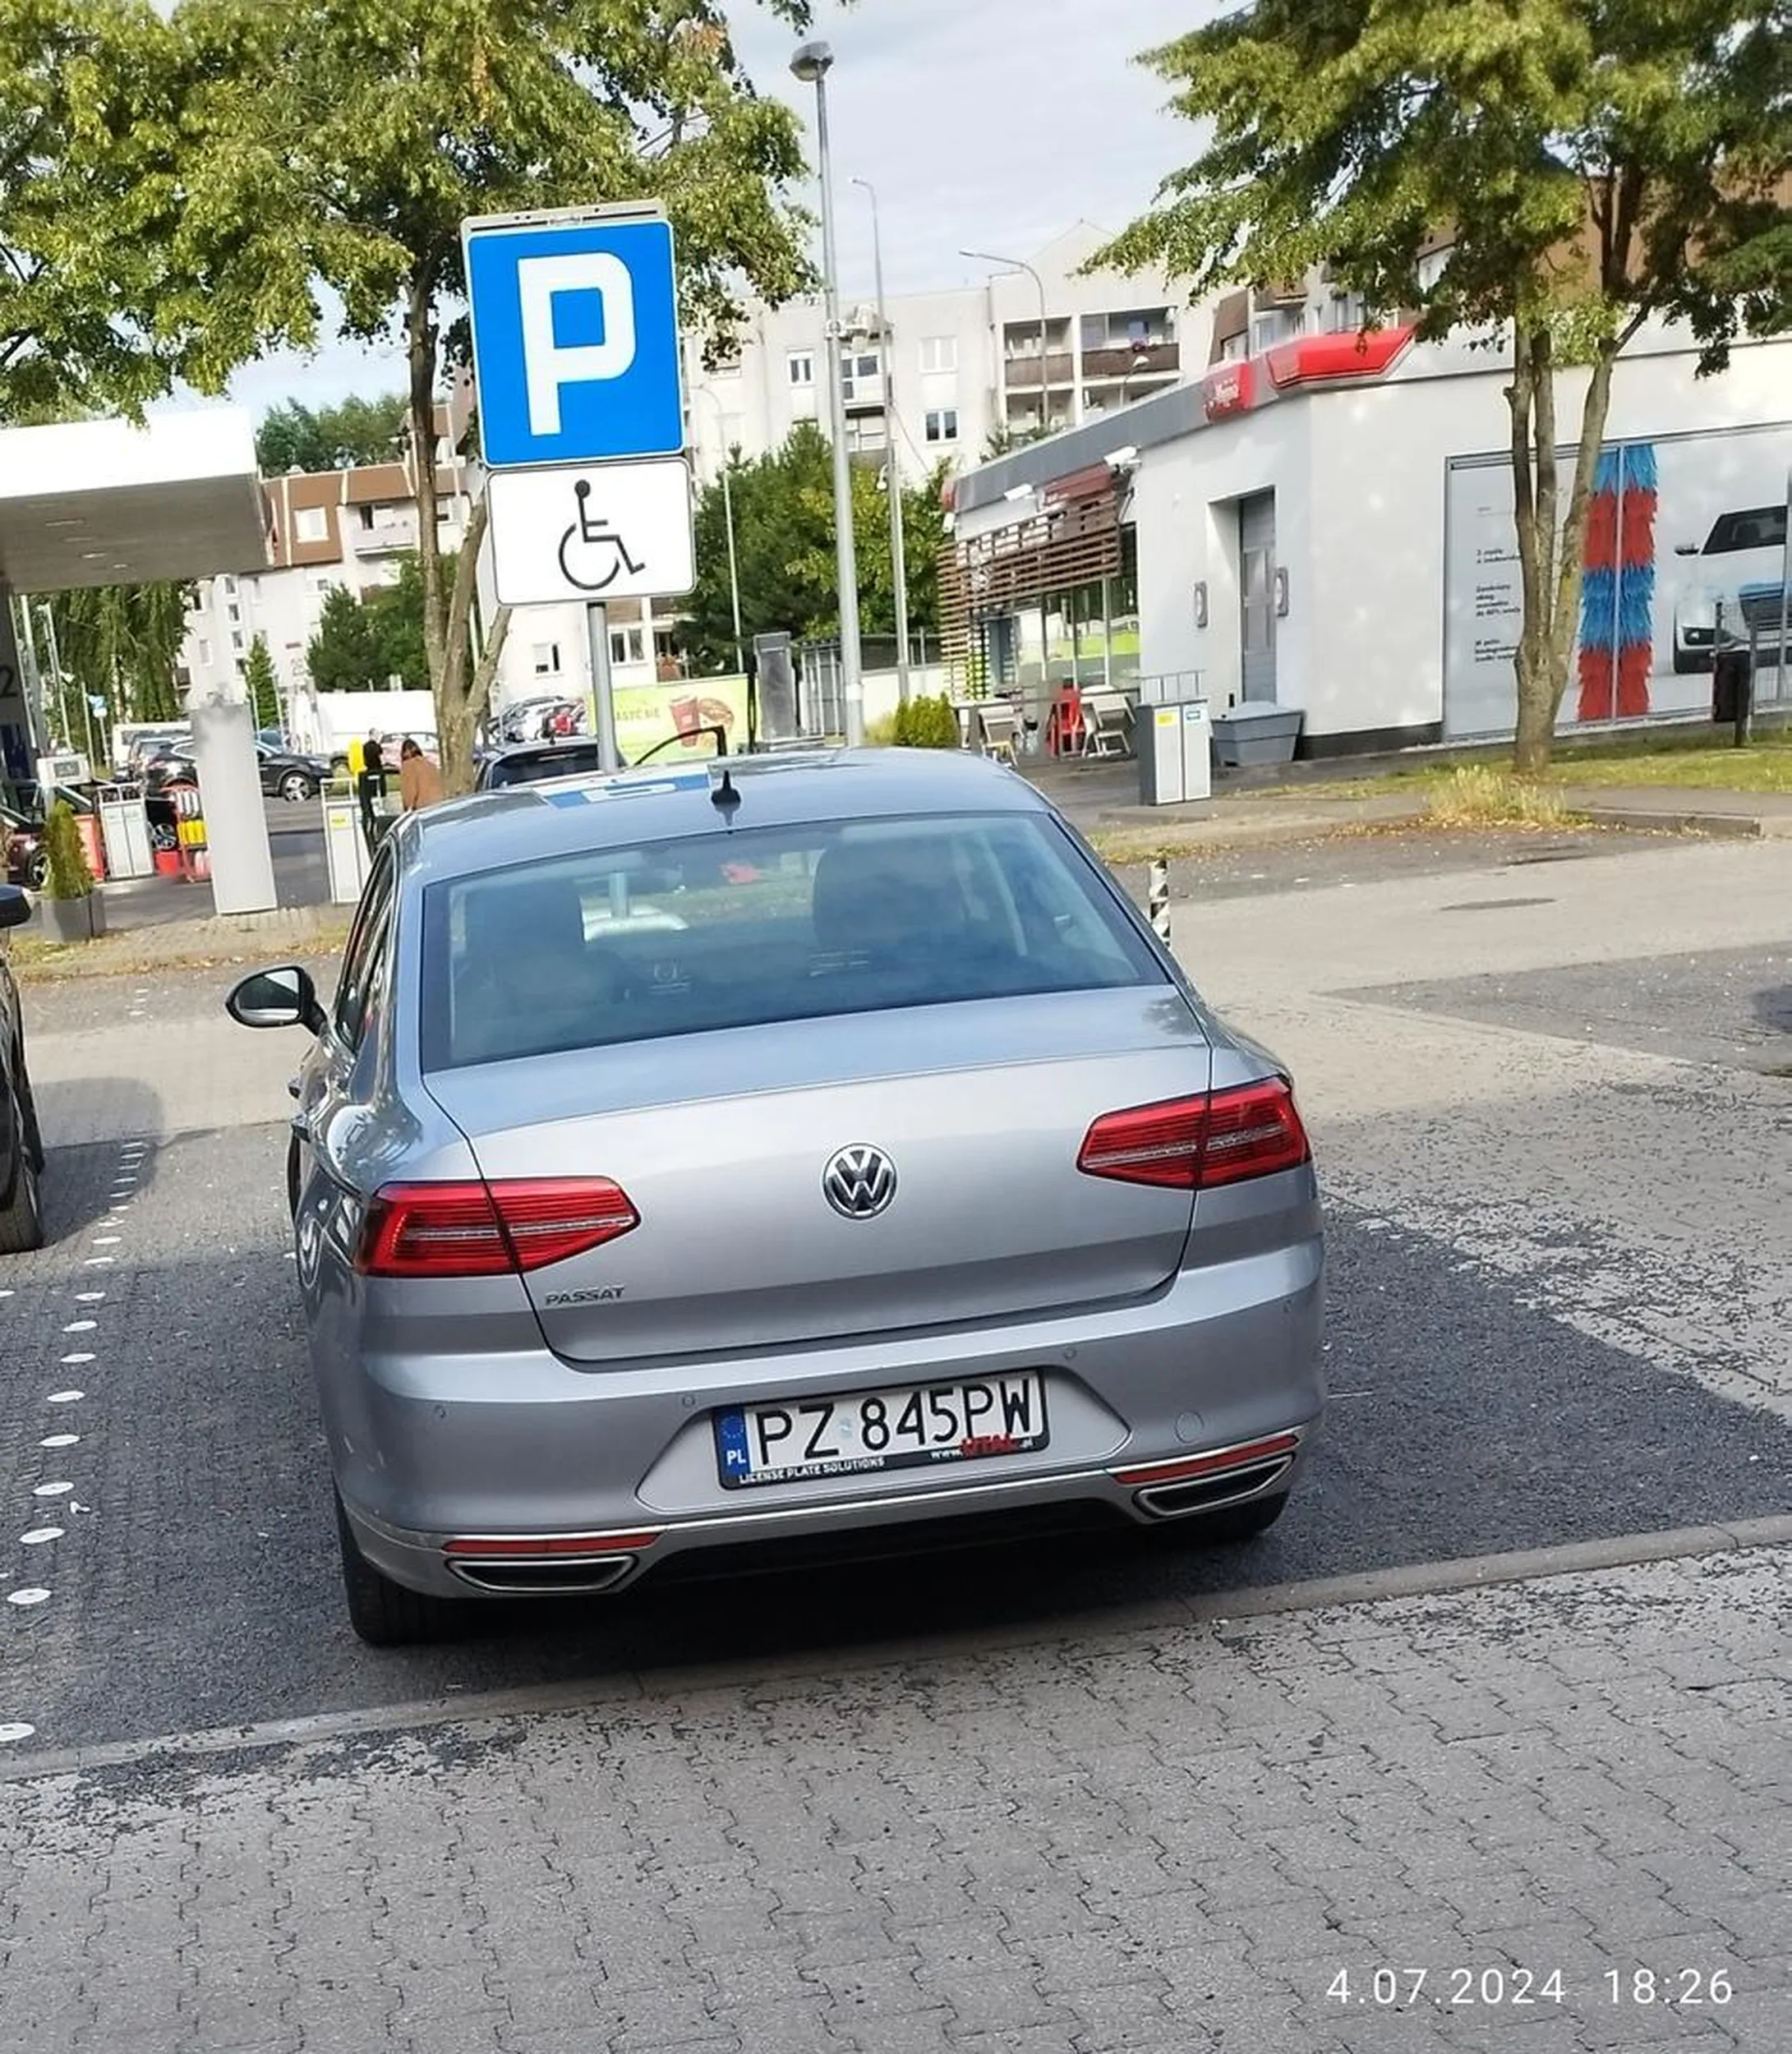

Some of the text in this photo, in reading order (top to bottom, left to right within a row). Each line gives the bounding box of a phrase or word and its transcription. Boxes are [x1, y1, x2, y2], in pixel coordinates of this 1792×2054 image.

[518, 252, 637, 436] P
[545, 1285, 625, 1306] PASSAT
[755, 1378, 1030, 1466] PZ 845PW
[726, 1449, 747, 1467] PL
[739, 1456, 886, 1485] LICENSE PLATE SOLUTIONS
